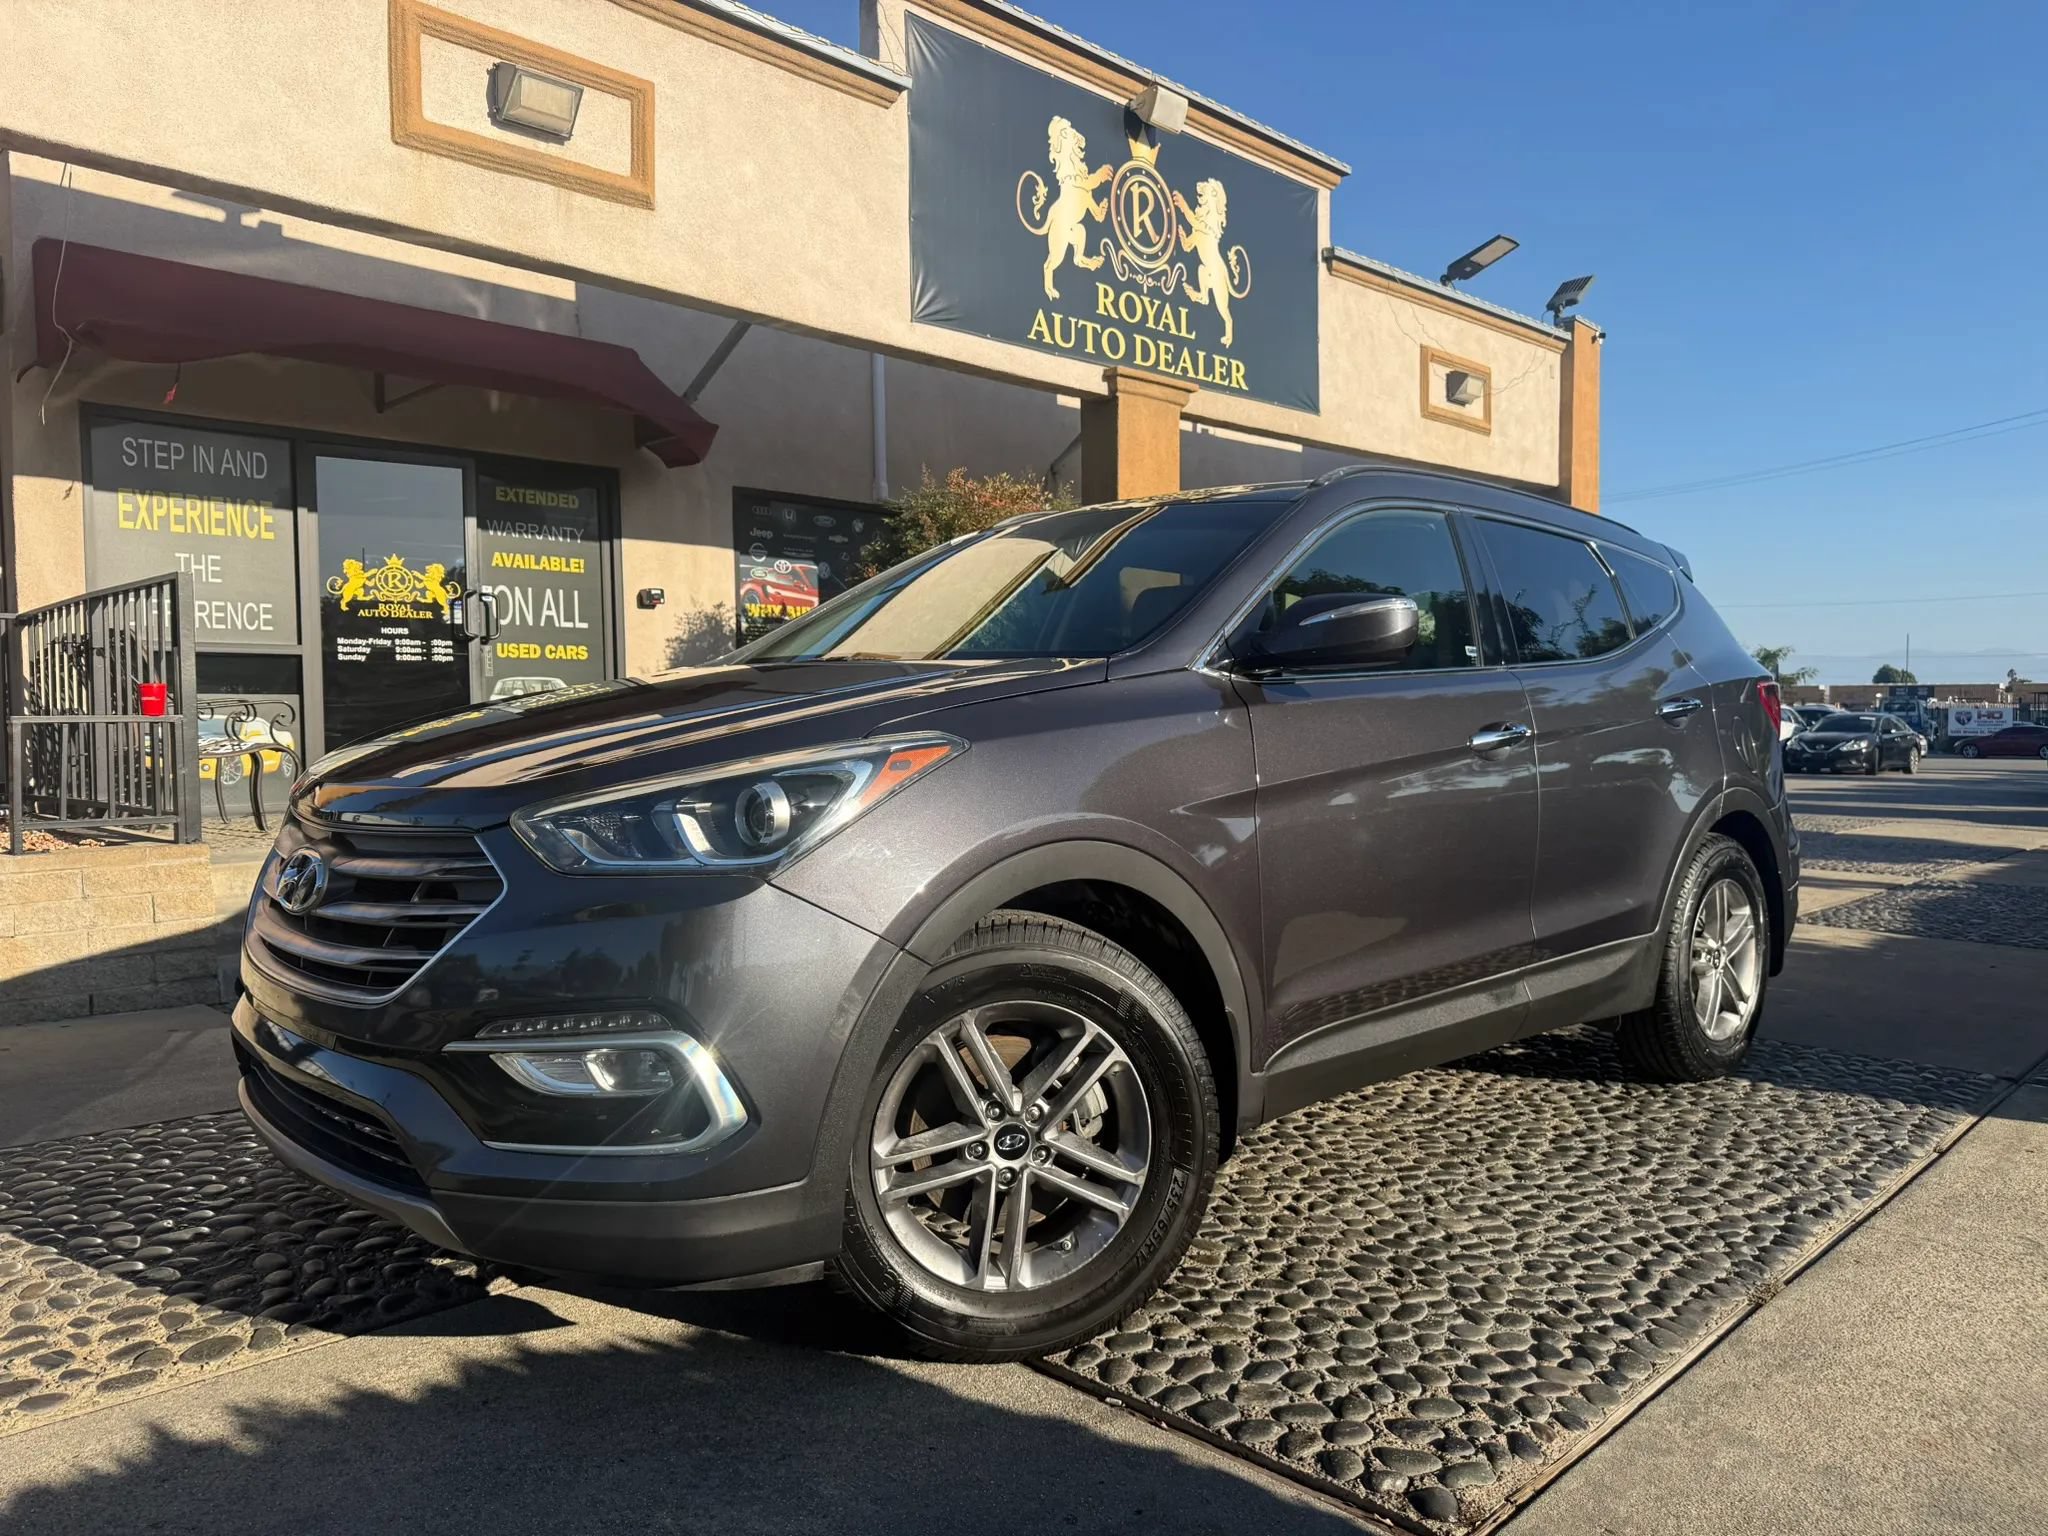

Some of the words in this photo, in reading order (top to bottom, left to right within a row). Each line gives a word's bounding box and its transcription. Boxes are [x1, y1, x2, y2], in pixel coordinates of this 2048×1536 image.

[1095, 281, 1196, 340] ROYAL
[1027, 307, 1127, 361] AUTO
[1132, 333, 1249, 391] DEALER
[122, 436, 185, 471] STEP
[192, 444, 215, 475] IN
[219, 448, 268, 480] AND
[495, 485, 580, 509] EXTENDED
[117, 487, 275, 541] EXPERIENCE
[486, 519, 585, 544] WARRANTY
[749, 527, 773, 540] Jeep
[174, 552, 223, 583] THE
[490, 551, 585, 574] AVAILABLE!
[357, 609, 389, 618] AUTO
[391, 610, 434, 620] DEALER
[377, 602, 414, 612] ROYAL
[492, 584, 533, 627] ON
[539, 587, 589, 630] ALL
[336, 637, 392, 647] Monday-Friday
[394, 638, 421, 647] 9:00am
[380, 626, 409, 636] HOURS
[337, 644, 372, 654] Saturday
[395, 646, 422, 654] 9:00am
[337, 653, 367, 662] Sunday
[395, 654, 422, 662] 9:00am
[496, 642, 541, 660] USED
[544, 644, 589, 661] CARS
